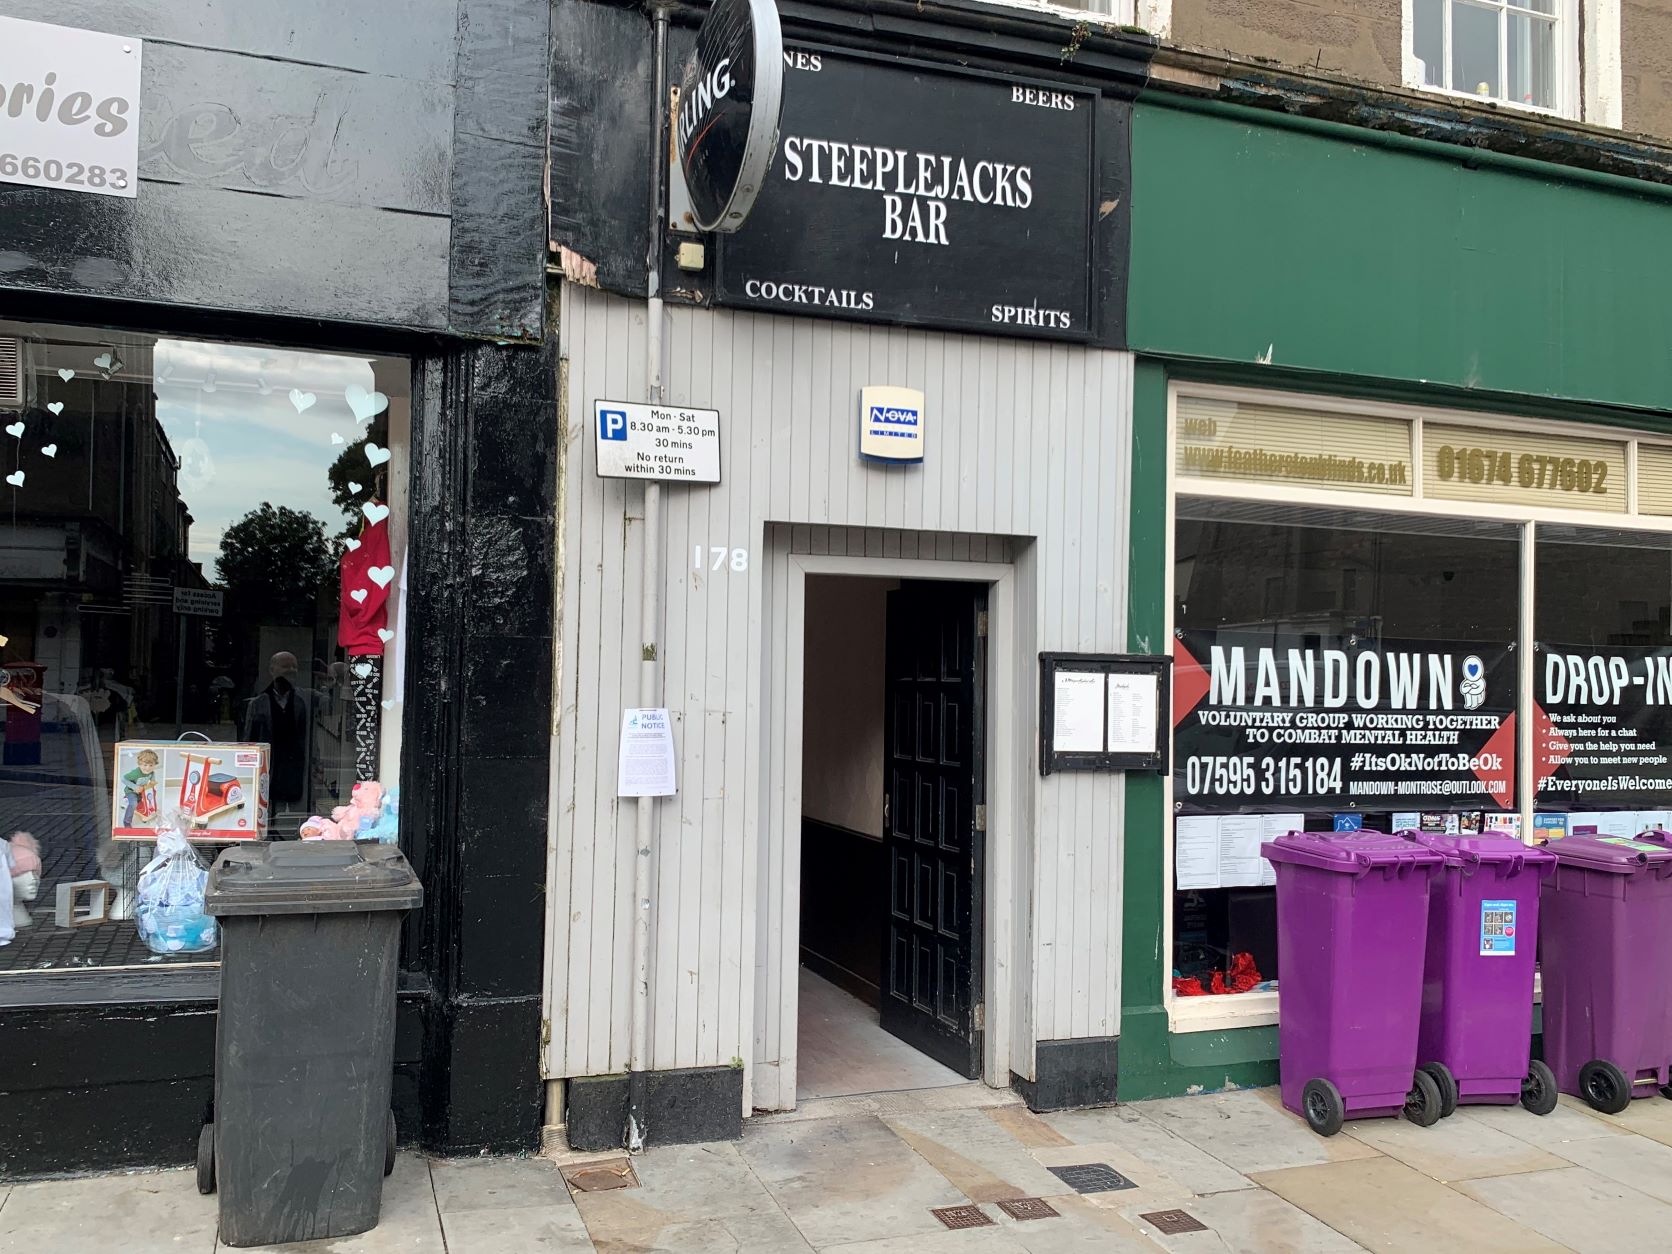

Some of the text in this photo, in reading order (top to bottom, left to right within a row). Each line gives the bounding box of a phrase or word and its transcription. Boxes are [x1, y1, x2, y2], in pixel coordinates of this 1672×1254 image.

[0, 71, 130, 138] ries
[1011, 86, 1075, 110] BEERS
[0, 153, 128, 190] 660283
[784, 136, 1033, 209] STEEPLEJACKS
[882, 194, 950, 246] BAR
[744, 279, 874, 310] COCKTAILS
[991, 304, 1071, 329] SPIRITS
[606, 413, 624, 438] P
[651, 410, 671, 420] Mon
[679, 413, 695, 422] Sat
[630, 422, 653, 432] 8.30
[656, 425, 670, 433] am
[677, 426, 700, 436] 5.30
[701, 429, 715, 437] pm
[1184, 417, 1217, 437] web
[655, 438, 693, 449] 30 mins
[637, 452, 684, 463] No return
[625, 464, 696, 476] within 30 mins
[1438, 445, 1608, 494] 01674 677602
[695, 545, 748, 572] 178
[1209, 645, 1453, 710] MANDOWN
[1198, 711, 1500, 729] VOLUNTARY GROUP WORKING TOGETHER
[1548, 713, 1616, 724] We ask about you
[1246, 729, 1459, 744] TO COMBAT MENTAL HEALTH
[1548, 727, 1577, 738] Always
[1578, 728, 1596, 736] here
[1598, 728, 1610, 736] for
[1618, 728, 1637, 736] chat
[1548, 741, 1656, 752] Give you the help you need
[1350, 752, 1502, 771] #ItsOkNotToBeOk
[1548, 755, 1573, 764] Allow
[1575, 757, 1589, 766] you
[1590, 756, 1600, 764] to
[1600, 756, 1621, 764] meet
[1639, 755, 1667, 765] people
[1186, 755, 1342, 795] 07595 315184
[1537, 776, 1672, 793] #EveryoneIsWelcome
[1350, 780, 1506, 795] MANDOWN-MONTROSE@OUTLOOK.COM
